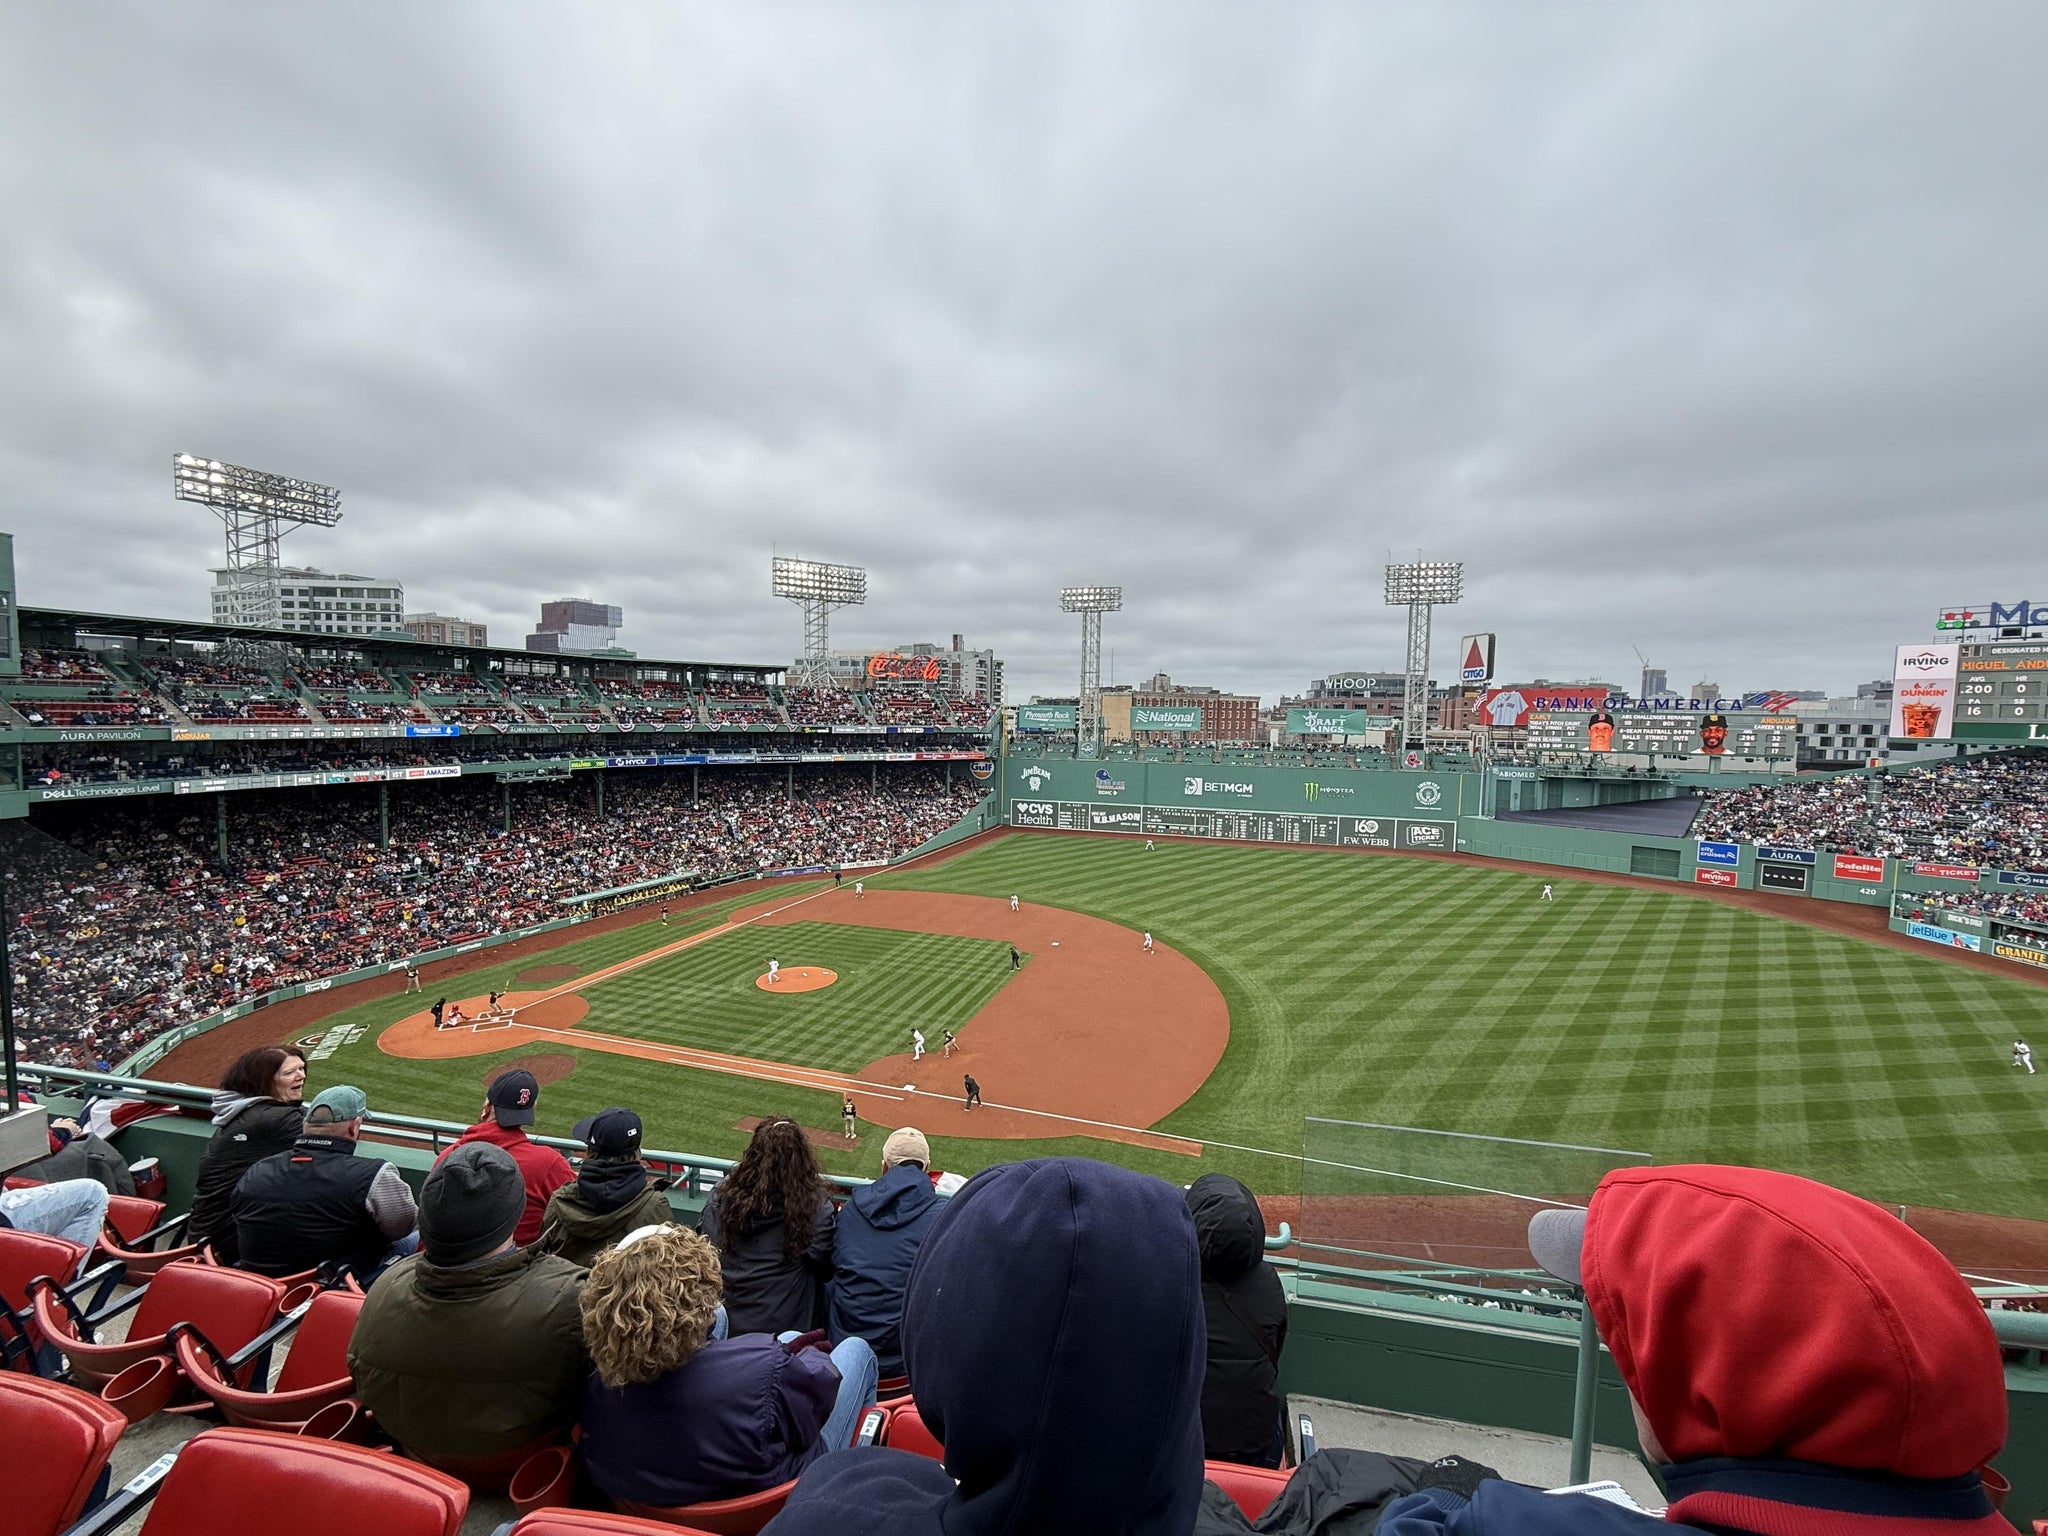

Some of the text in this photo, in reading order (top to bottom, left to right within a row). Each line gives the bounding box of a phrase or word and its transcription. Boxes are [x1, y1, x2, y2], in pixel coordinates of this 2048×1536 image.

[1903, 657, 1949, 666] IRVING
[1962, 661, 2010, 670] MIGUEL
[1463, 668, 1484, 678] CITGO
[1324, 678, 1376, 689] WHOOP
[1901, 689, 1947, 697] DUNKIN'
[1960, 684, 2026, 694] .200 0
[1536, 697, 1743, 711] BANK OF AMERICA
[1024, 710, 1053, 720] Plymouth
[1054, 710, 1070, 719] Rock
[1967, 707, 2024, 716] 16 0
[1149, 712, 1194, 722] National
[1305, 718, 1346, 727] DRAFT
[97, 731, 141, 740] PAVILION
[1626, 741, 1634, 750] 2
[1651, 742, 1659, 751] 2
[970, 762, 992, 771] Gulf
[426, 768, 458, 776] AMAZING
[1033, 765, 1051, 780] BEAM
[43, 783, 160, 800] DELL Technologies Level
[1204, 782, 1253, 793] BETMGM
[1319, 786, 1355, 794] MONSTER
[1029, 803, 1054, 815] CVS
[1018, 814, 1054, 826] Health
[1354, 819, 1379, 834] 160
[1413, 826, 1440, 836] ACE
[1343, 837, 1390, 847] F.W. WEBB
[1836, 861, 1882, 872] Safelite
[1702, 873, 1731, 882] IRVING
[1939, 869, 1978, 877] TICKET
[1859, 887, 1877, 896] 420
[1911, 924, 1948, 941] jetBlue
[1996, 946, 2047, 963] GRANITE
[517, 1088, 531, 1106] B
